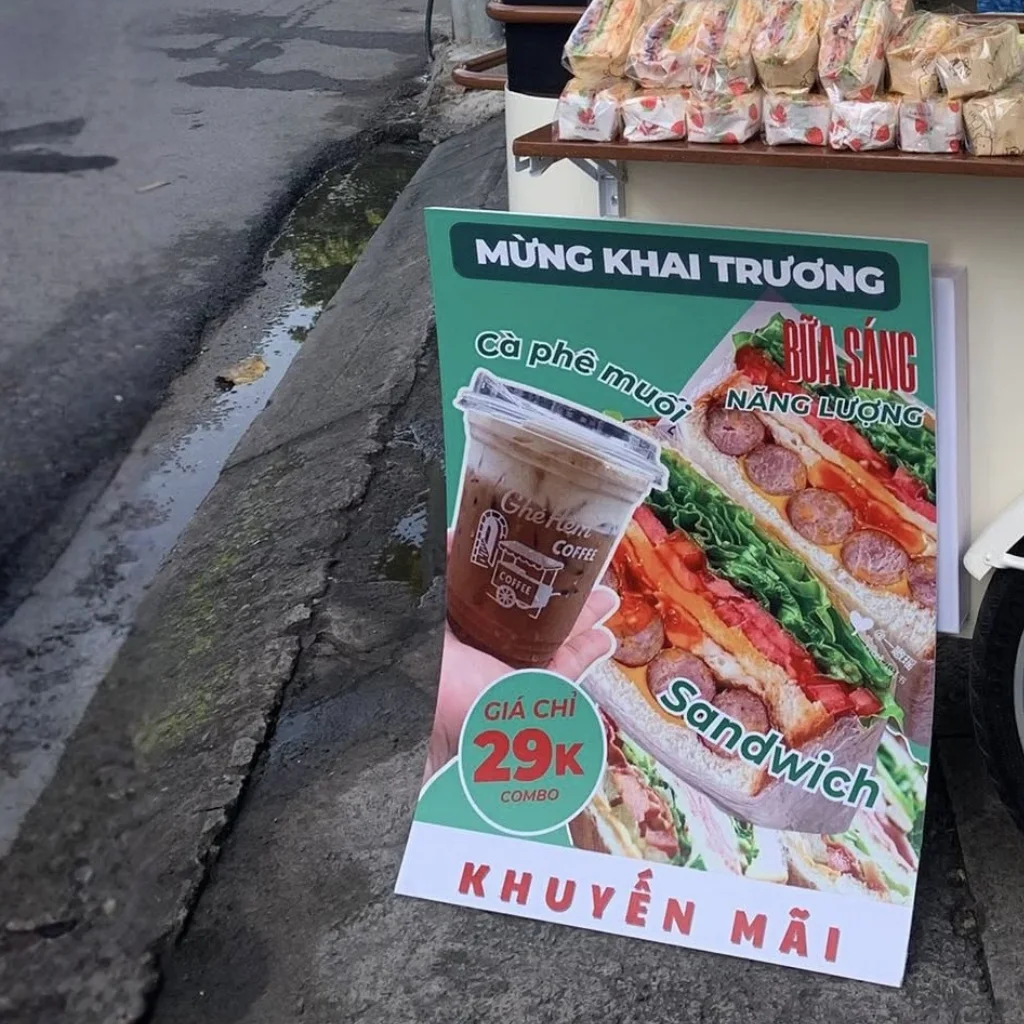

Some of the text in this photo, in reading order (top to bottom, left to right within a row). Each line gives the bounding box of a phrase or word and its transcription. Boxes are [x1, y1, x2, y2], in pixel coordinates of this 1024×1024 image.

[475, 234, 886, 295] MỪNG KHAI TRƯƠNG
[476, 330, 692, 423] Cà phê muối
[783, 314, 917, 394] BỮA SÁNG
[726, 388, 925, 428] NĂNG LƯỢNG
[552, 539, 599, 562] COFFEE
[500, 571, 532, 596] COFFEE
[483, 691, 577, 721] GIÁ CHỈ
[472, 728, 585, 784] 29K
[658, 676, 881, 810] Sandwich
[499, 787, 560, 804] COMBO
[458, 861, 843, 962] KHUYẾN MÃI
